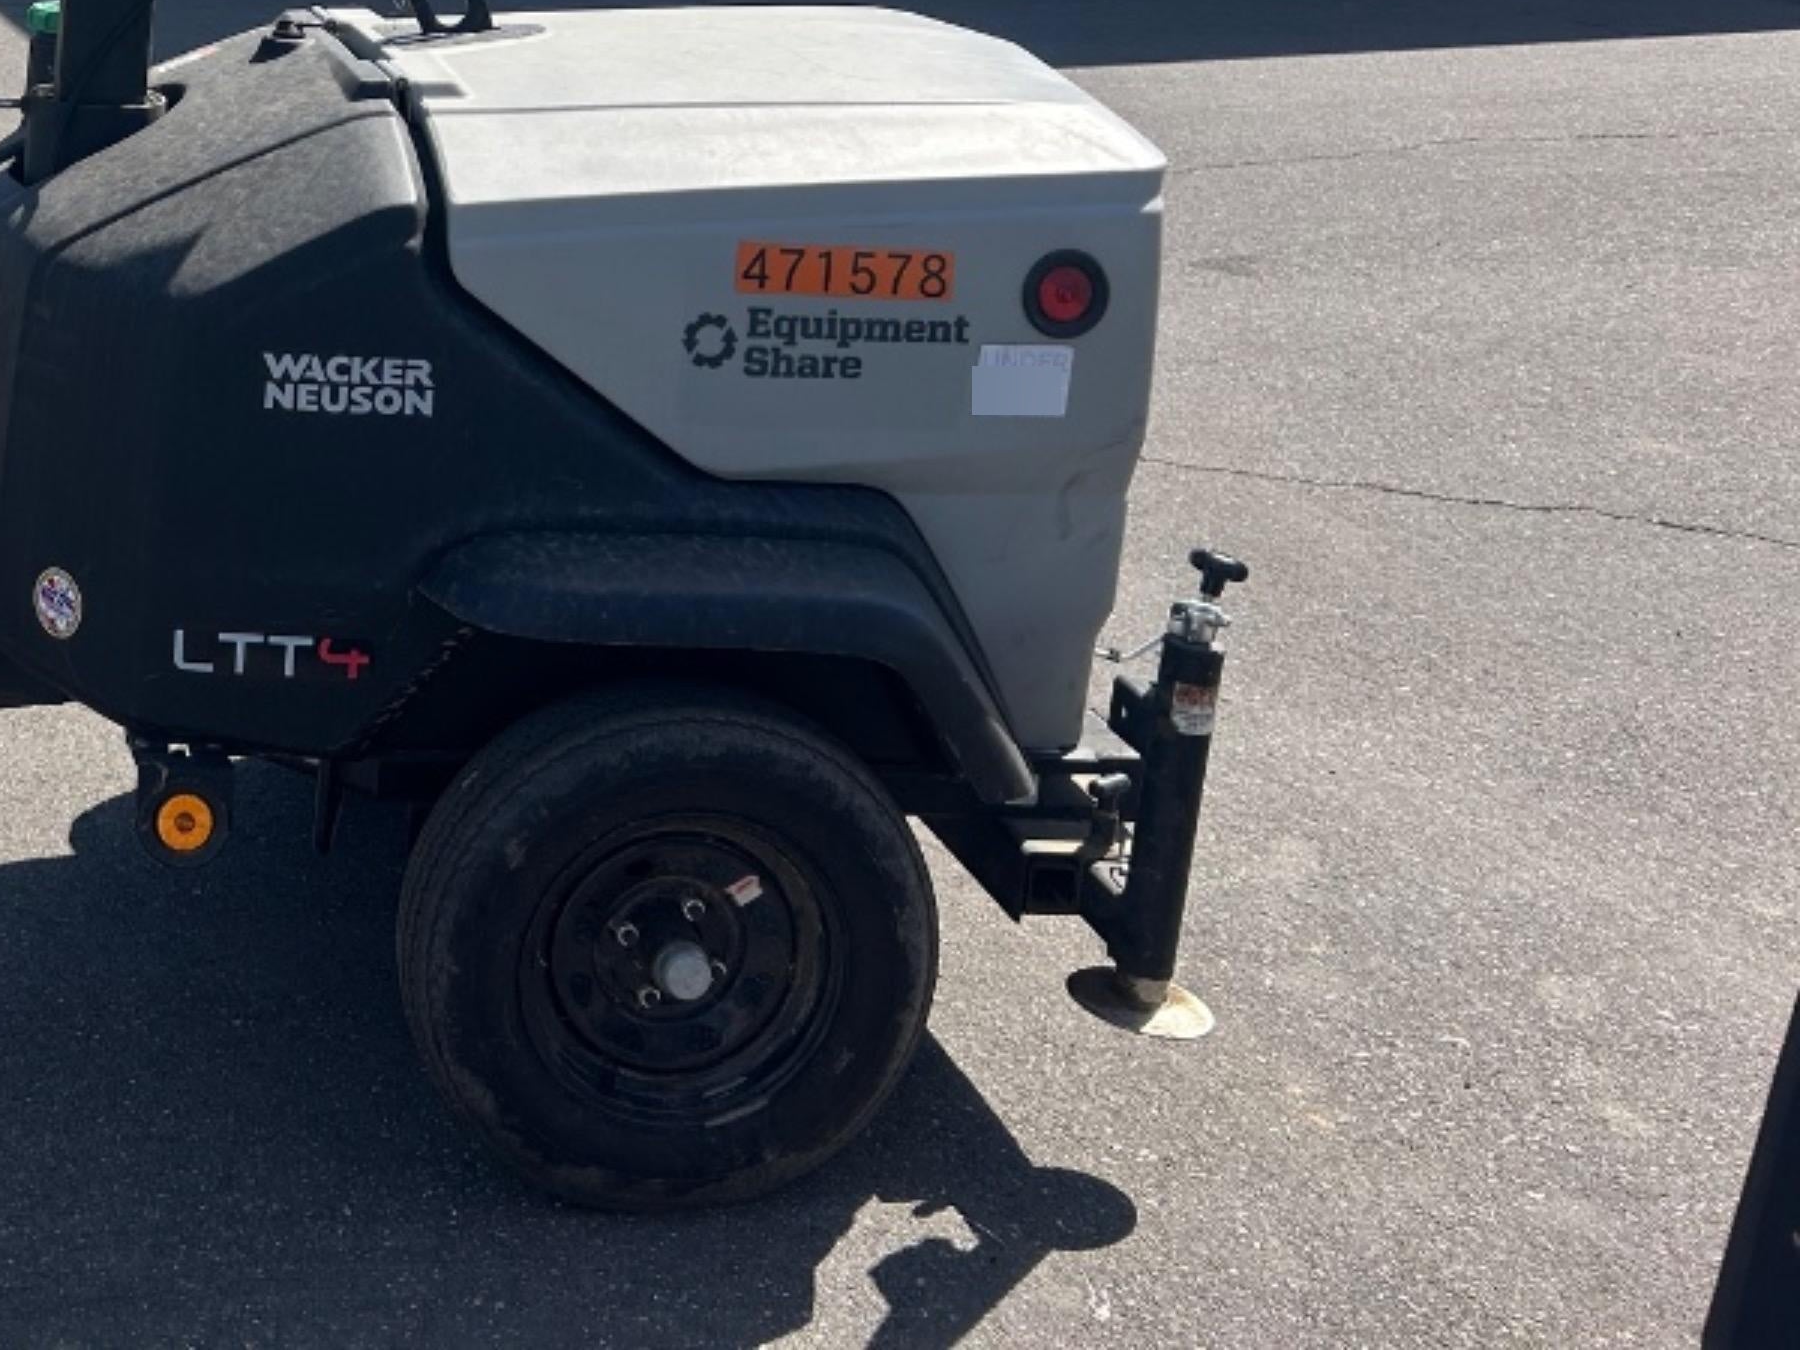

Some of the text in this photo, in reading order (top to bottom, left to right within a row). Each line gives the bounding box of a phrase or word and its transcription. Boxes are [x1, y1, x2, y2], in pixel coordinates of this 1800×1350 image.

[742, 248, 947, 298] 471578
[747, 307, 970, 348] Equipment
[263, 352, 435, 387] WACKER
[743, 346, 863, 379] Share
[263, 381, 435, 418] NEUSON
[173, 629, 370, 679] LTT4
